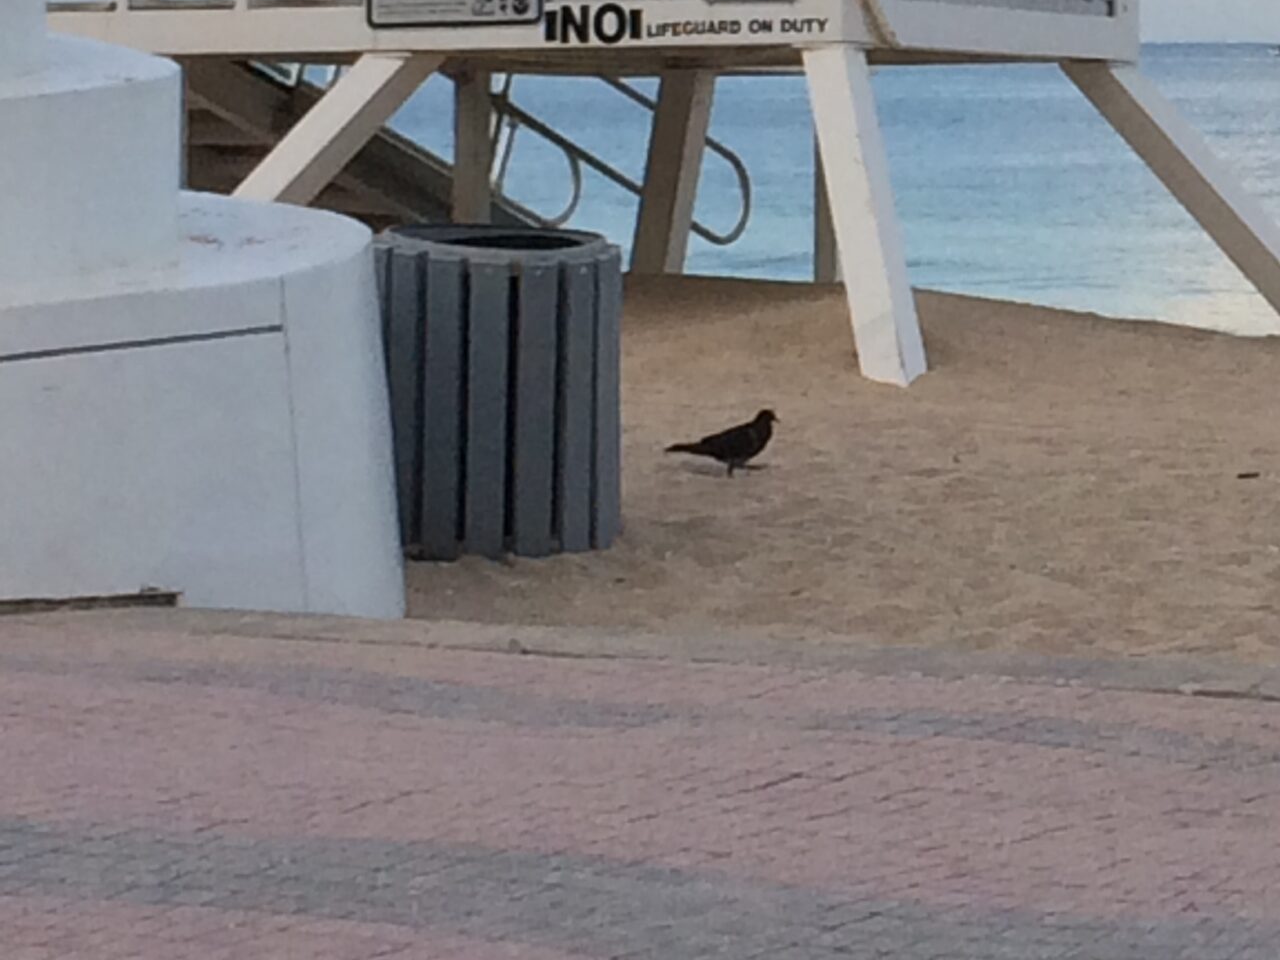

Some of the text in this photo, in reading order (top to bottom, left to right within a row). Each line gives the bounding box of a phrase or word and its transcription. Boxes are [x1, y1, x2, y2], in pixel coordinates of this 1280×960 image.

[646, 20, 741, 37] LIFEGUARD
[748, 19, 773, 34] ON
[781, 17, 828, 33] DUTY
